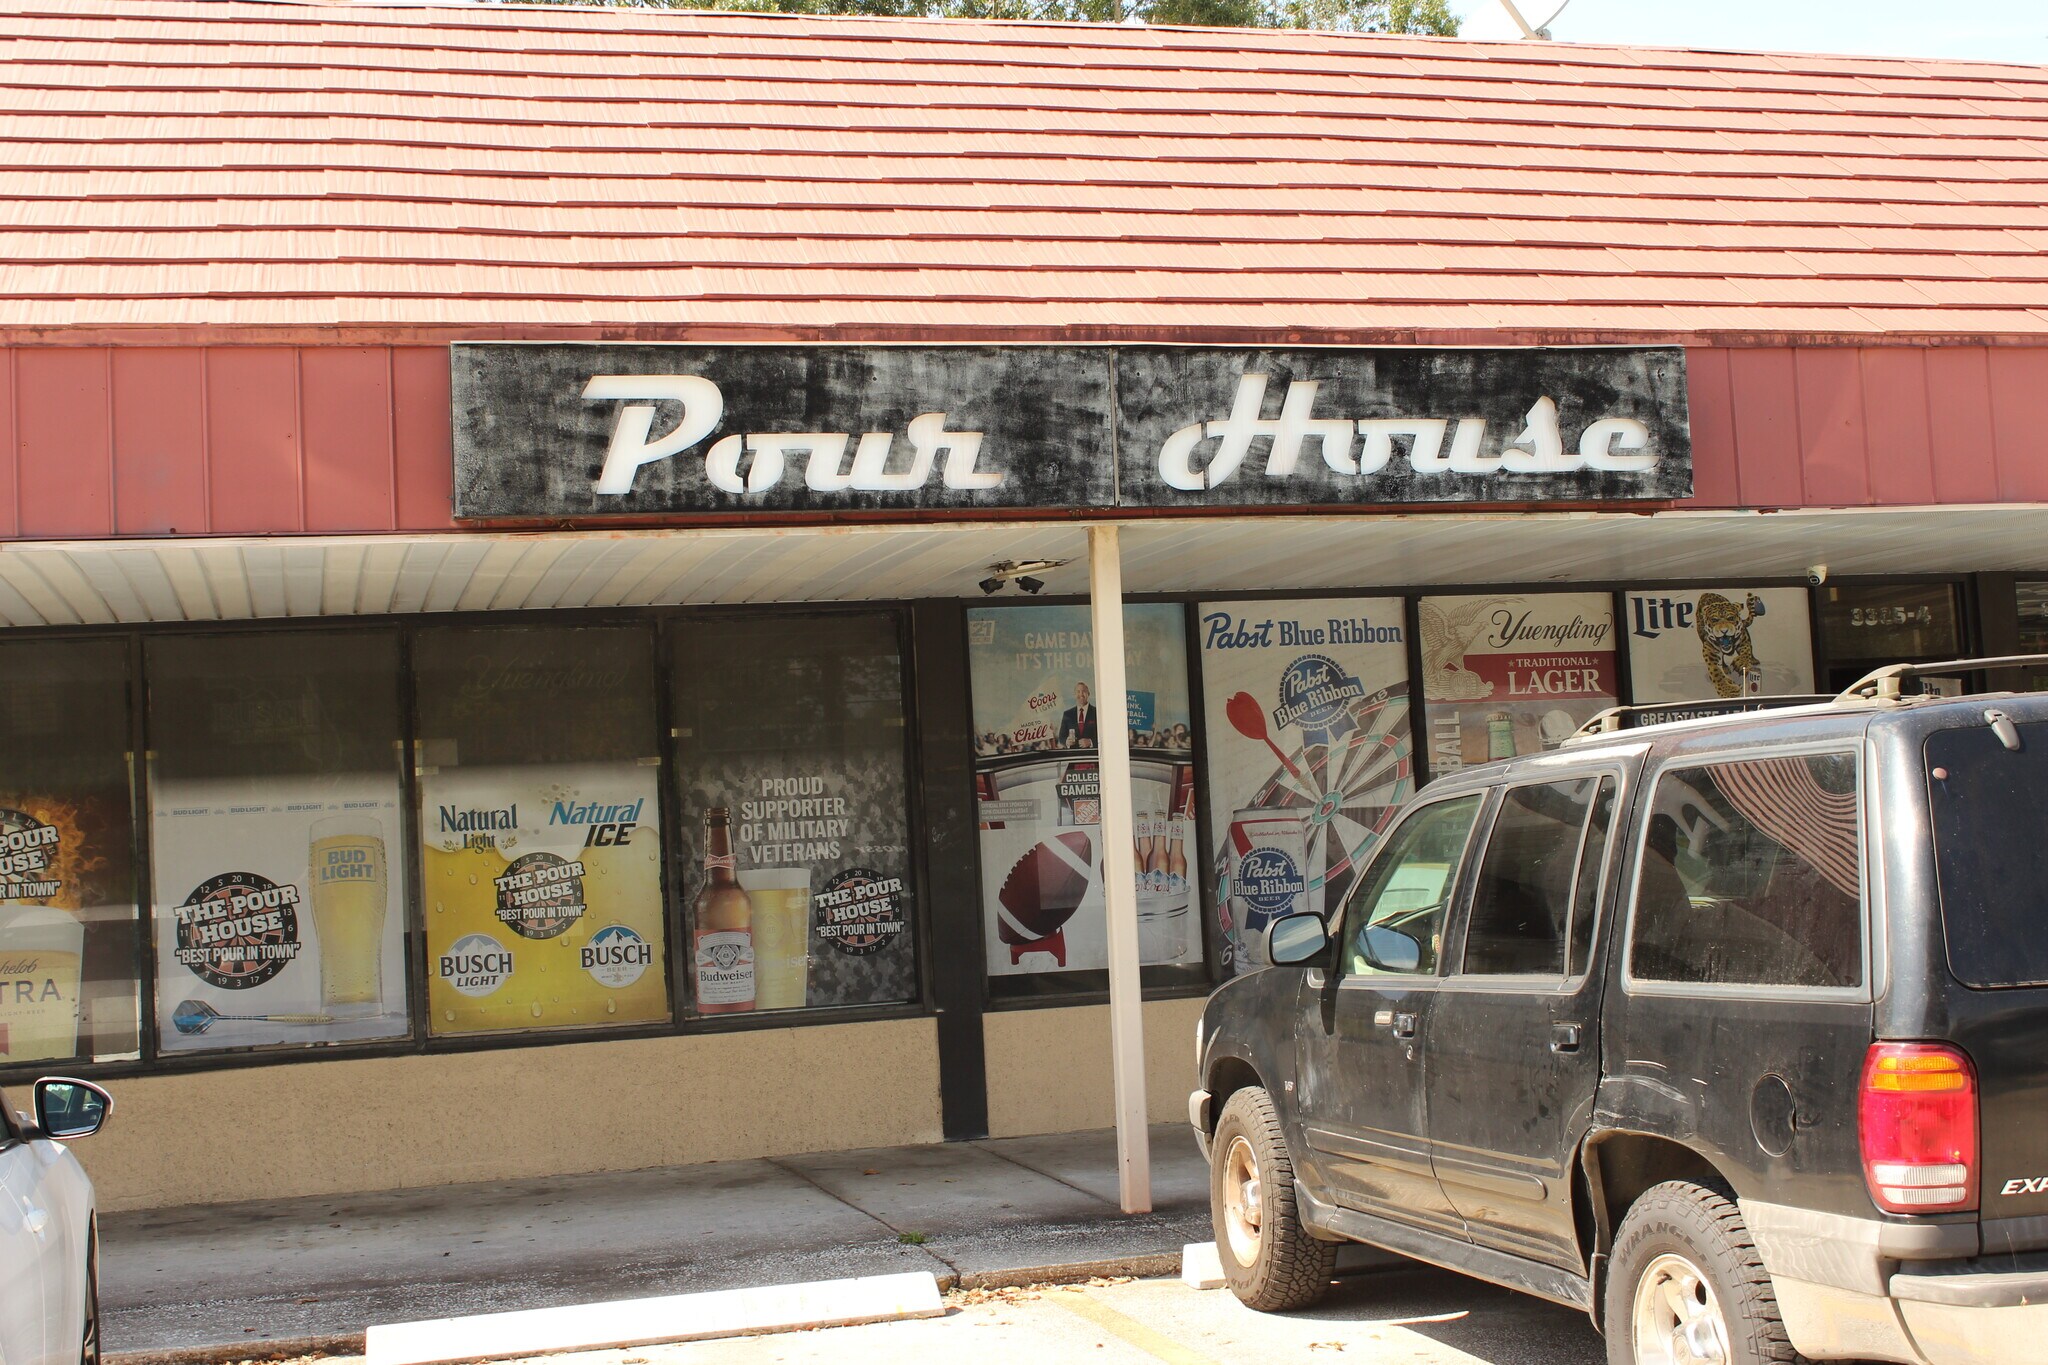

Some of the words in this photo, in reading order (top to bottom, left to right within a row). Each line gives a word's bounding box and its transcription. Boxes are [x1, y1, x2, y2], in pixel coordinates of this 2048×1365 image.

[581, 375, 1004, 494] Pour
[1158, 374, 1661, 490] House
[1488, 609, 1613, 648] Yuengling
[1630, 597, 1694, 639] Lite
[1024, 632, 1067, 649] GAME
[1203, 612, 1274, 650] Pabst
[1278, 620, 1325, 646] Blue
[1328, 618, 1403, 645] Ribbon
[1044, 652, 1073, 669] THE
[1516, 656, 1592, 668] TRADITIONAL
[1285, 664, 1330, 698] Pabst
[1508, 668, 1602, 695] LAGER
[1028, 692, 1057, 709] Coors
[1275, 701, 1309, 727] Blue
[1306, 683, 1362, 709] Ribbon
[1310, 704, 1334, 718] BEER
[1640, 711, 1681, 726] GREAT
[1013, 724, 1048, 743] Chill
[1434, 711, 1462, 777] BALL
[762, 776, 823, 797] PROUD
[1066, 773, 1099, 783] COLLEG
[1061, 784, 1099, 796] GAMED
[440, 803, 518, 832] Natural
[549, 798, 644, 825] Natural
[741, 797, 846, 820] SUPPORTER
[584, 823, 637, 848] ICE
[740, 823, 764, 842] OF
[768, 818, 849, 841] MILITARY
[463, 833, 496, 854] Light
[750, 841, 840, 864] VETERANS
[327, 850, 366, 865] BUD
[1247, 857, 1287, 878] Pabst
[322, 864, 373, 881] LIGHT
[495, 872, 533, 892] THE
[535, 862, 584, 884] POUR
[8, 884, 20, 898] IN
[513, 881, 573, 906] HOUSE
[814, 888, 852, 908] THE
[854, 878, 902, 900] POUR
[1234, 880, 1258, 896] Blue
[1260, 878, 1304, 895] Ribbon
[174, 899, 228, 925] THE
[231, 886, 299, 914] POUR
[523, 907, 546, 919] POUR
[547, 906, 556, 918] IN
[833, 897, 892, 922] HOUSE
[200, 911, 283, 944] HOUSE
[843, 923, 865, 935] POUR
[866, 923, 875, 934] IN
[213, 946, 245, 962] POUR
[246, 945, 258, 960] IN
[440, 952, 513, 977] BUSCH
[581, 944, 652, 968] BUSCH
[1, 958, 40, 975] helob
[700, 970, 753, 982] Budweiser
[456, 975, 499, 987] LIGHT
